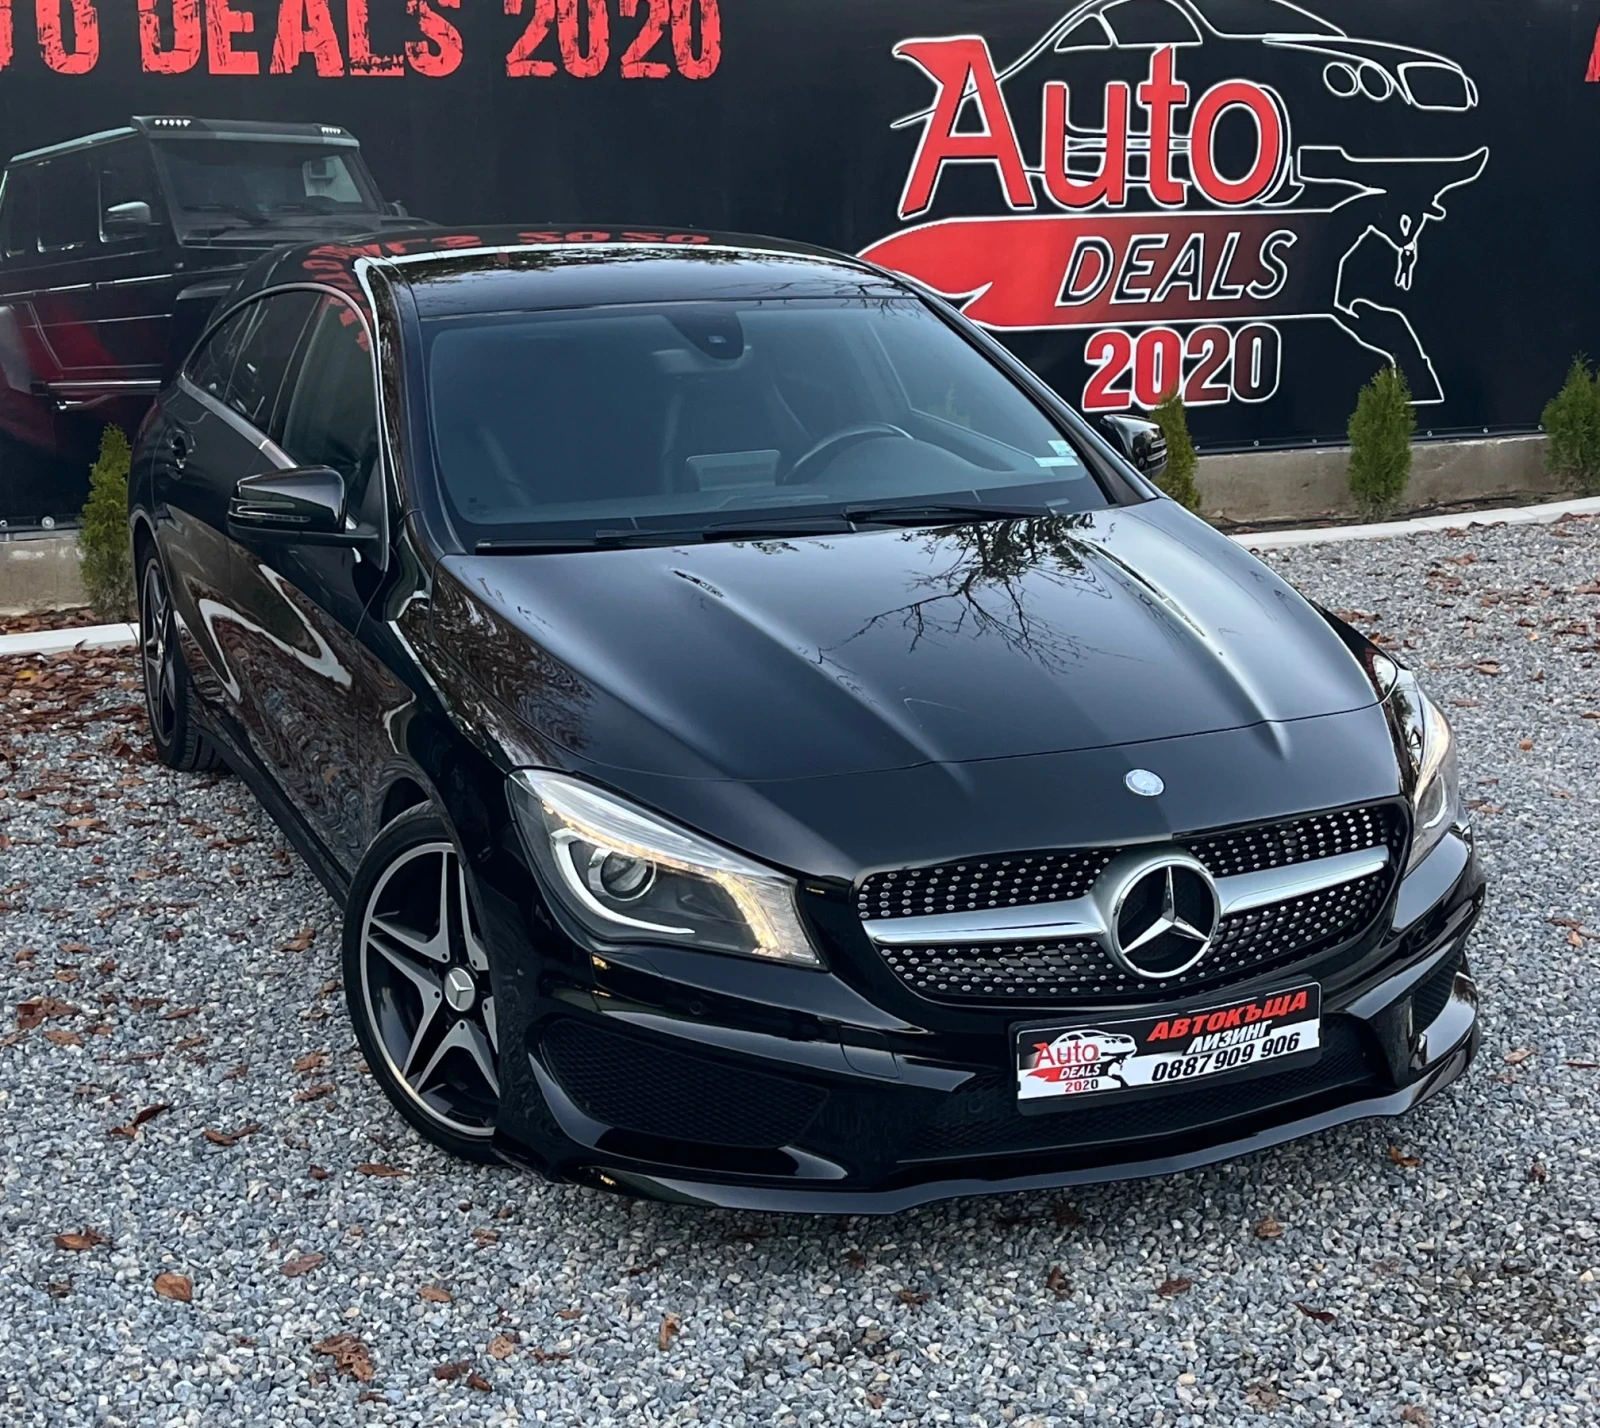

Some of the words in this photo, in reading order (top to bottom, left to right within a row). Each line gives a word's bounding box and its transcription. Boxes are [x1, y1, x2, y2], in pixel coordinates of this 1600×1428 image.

[138, 0, 463, 77] DEALS
[505, 0, 722, 79] 2020
[893, 36, 1284, 219] Auto
[1055, 230, 1298, 308] DEALS
[1082, 323, 1281, 411] 2020
[1147, 991, 1307, 1041] АВТОКЪЩА
[1182, 1020, 1272, 1056] ЛИЗИНГ
[1033, 1040, 1099, 1068] Auto
[1059, 1065, 1100, 1080] DEALS
[1151, 1053, 1213, 1082] 0887
[1214, 1043, 1252, 1070] 909
[1260, 1032, 1300, 1058] 906
[1065, 1079, 1099, 1093] 2020
